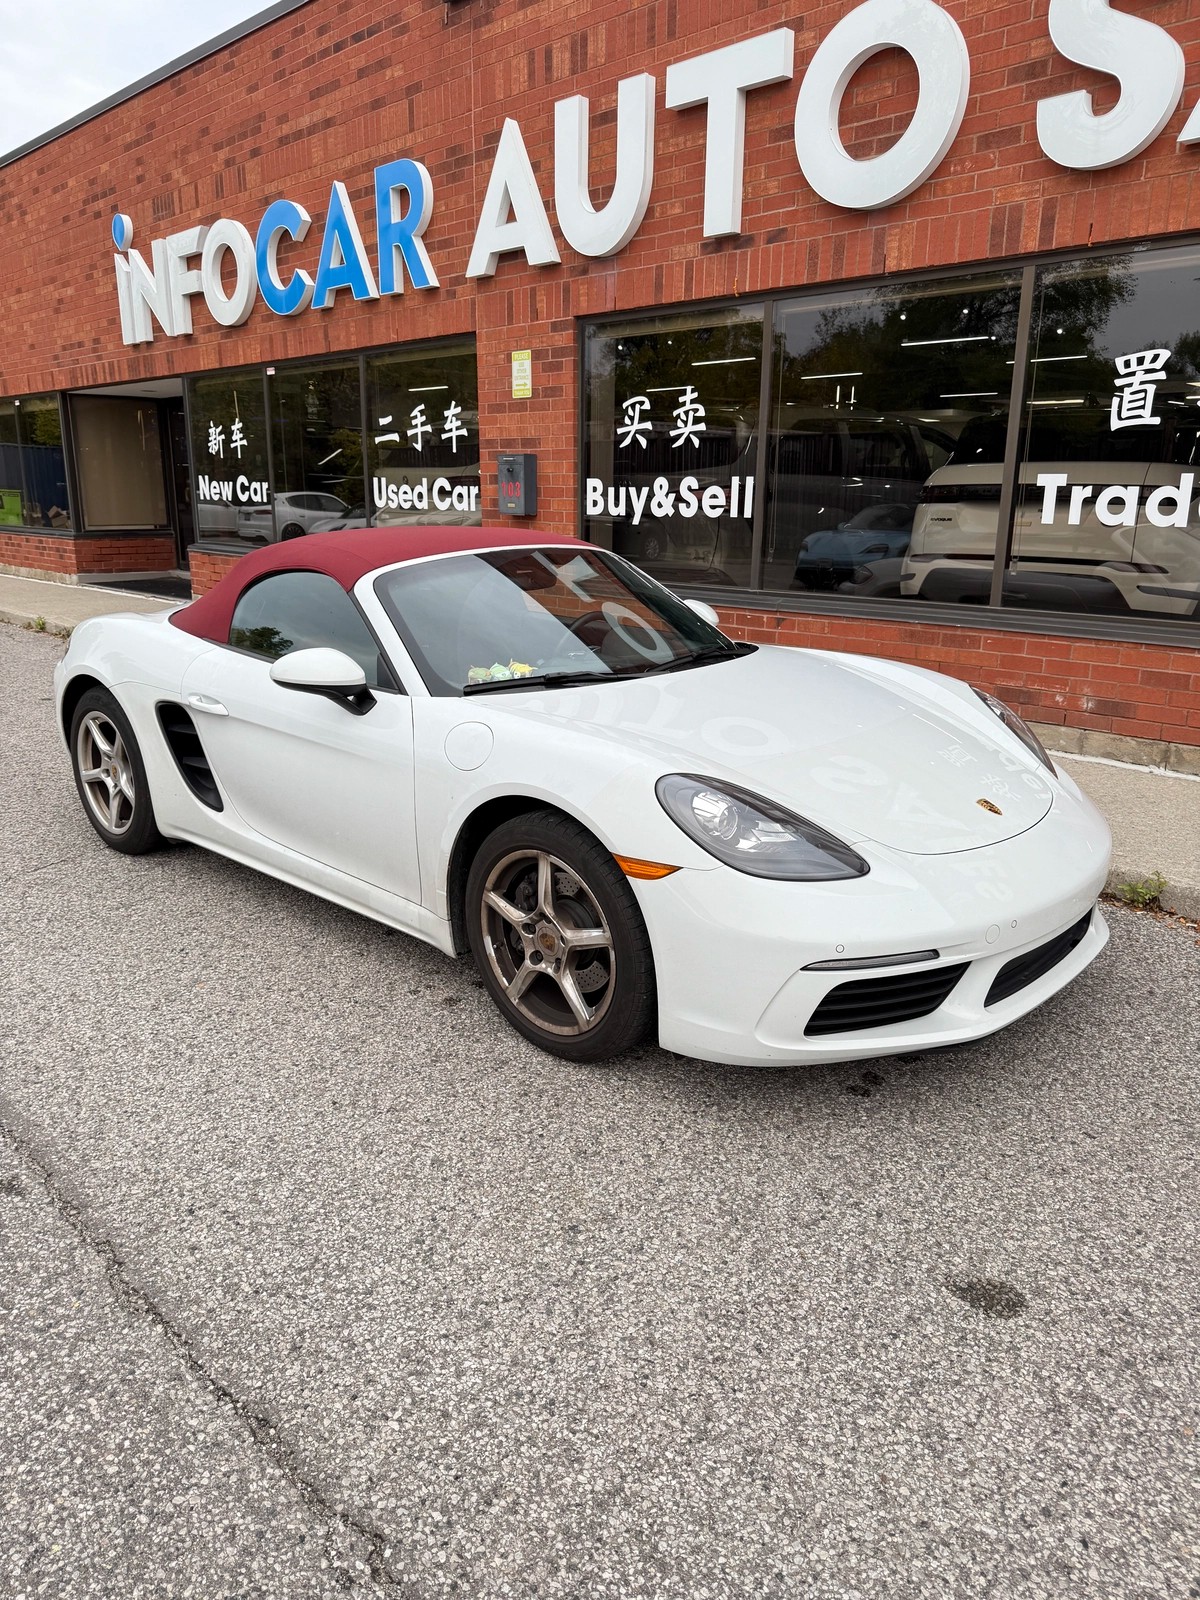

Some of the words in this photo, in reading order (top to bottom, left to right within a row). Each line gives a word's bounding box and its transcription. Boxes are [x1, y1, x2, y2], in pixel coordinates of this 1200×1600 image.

[465, 0, 970, 278] AUTO
[1036, 0, 1200, 171] S
[1110, 349, 1200, 431] 置
[208, 418, 248, 459] 新车
[374, 400, 468, 453] 二手车
[616, 386, 707, 449] 买卖
[198, 475, 233, 501] New
[236, 475, 269, 502] Car
[373, 477, 428, 510] Used
[432, 477, 479, 511] Car
[501, 481, 521, 498] 103
[586, 476, 754, 525] Buy&Sell
[1036, 472, 1200, 528] Trad
